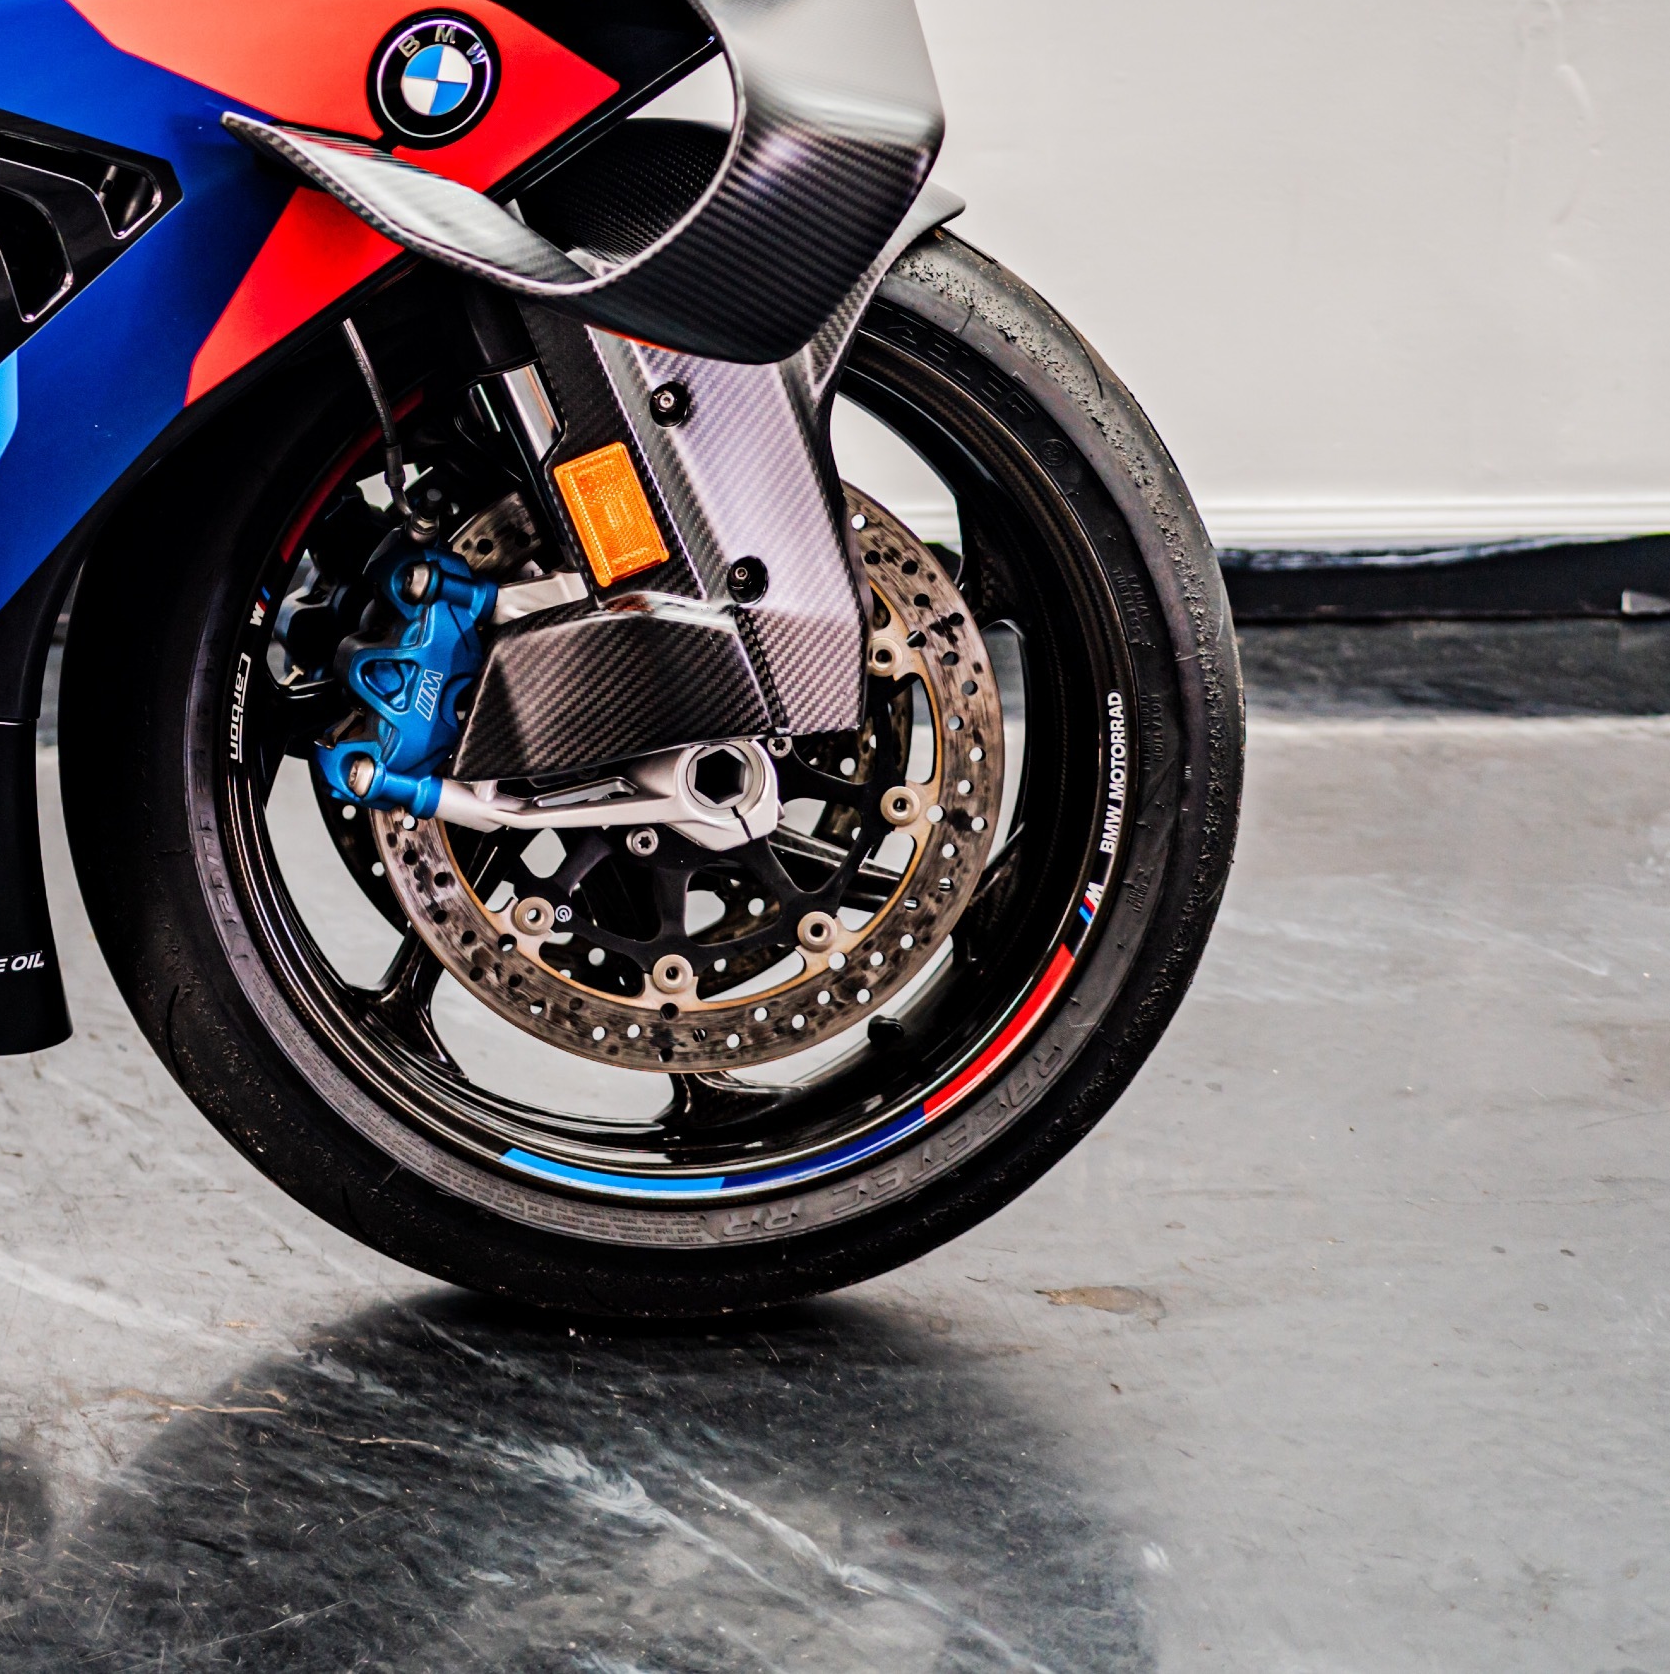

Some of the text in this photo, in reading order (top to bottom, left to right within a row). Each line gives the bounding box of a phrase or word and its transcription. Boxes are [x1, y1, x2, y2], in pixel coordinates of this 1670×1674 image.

[398, 25, 487, 64] BMW
[230, 652, 252, 764] Carbon
[1099, 691, 1127, 854] BMW MOTORRAD
[11, 951, 45, 971] OIL
[721, 1038, 1064, 1237] RACETEC RR
